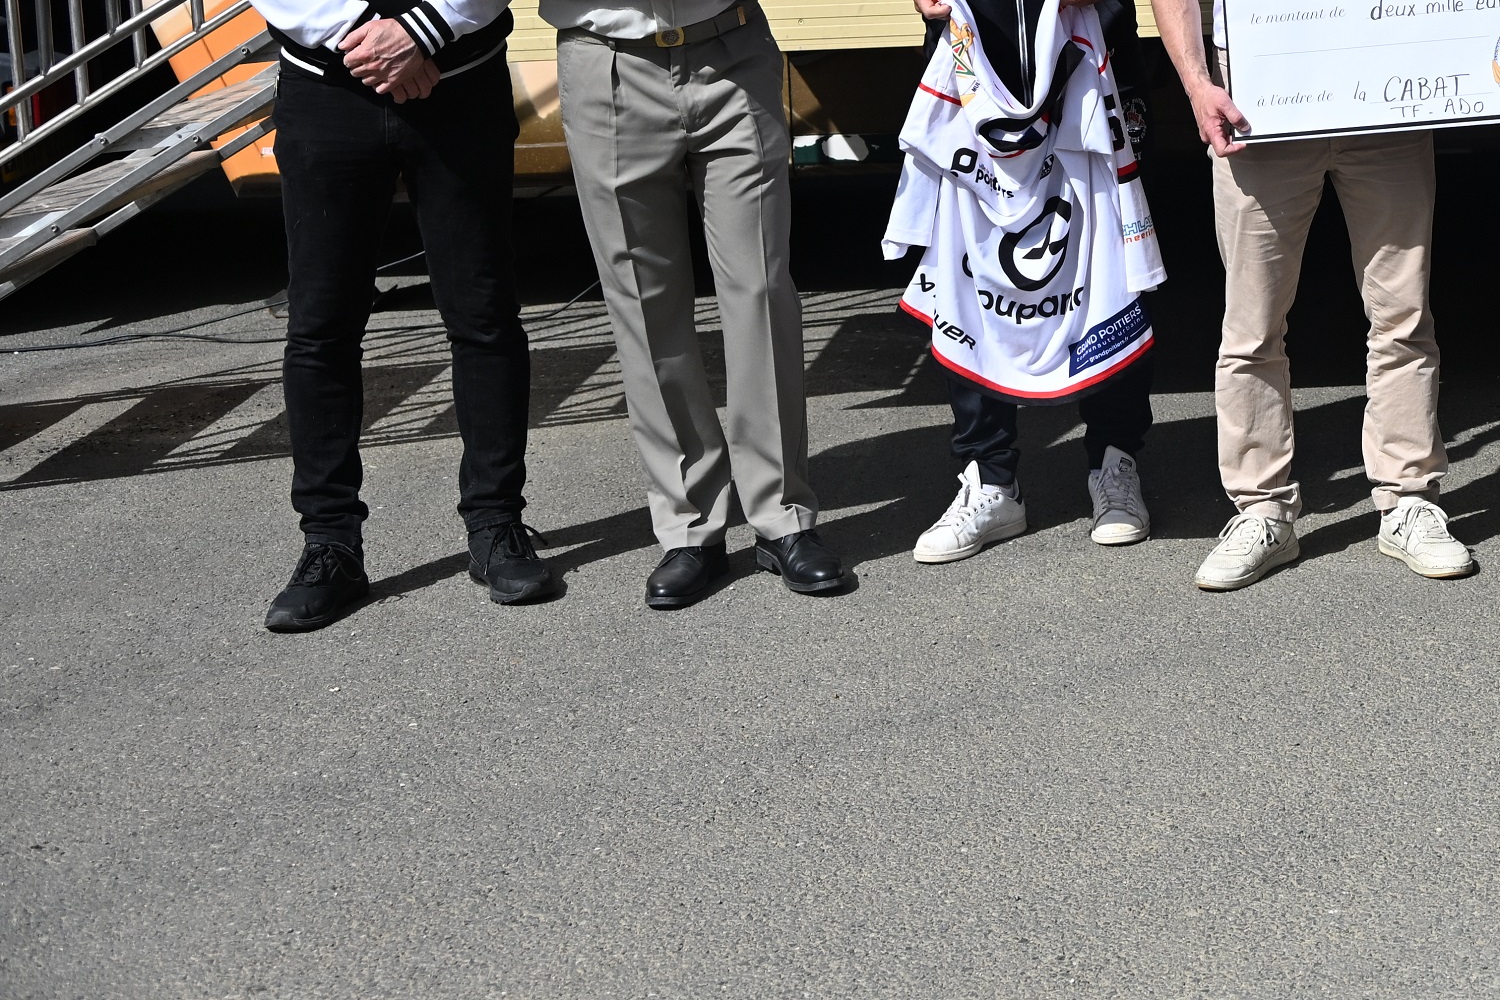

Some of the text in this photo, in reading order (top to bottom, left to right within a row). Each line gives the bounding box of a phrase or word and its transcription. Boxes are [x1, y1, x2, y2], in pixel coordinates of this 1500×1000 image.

[1250, 5, 1347, 25] le montant de
[1270, 91, 1313, 106] l'ordre
[1317, 89, 1335, 102] de
[1353, 80, 1367, 103] la
[1383, 73, 1470, 103] CABAT
[1390, 103, 1424, 118] TF
[1443, 98, 1485, 115] ADO
[975, 168, 1015, 199] poitirs
[1098, 305, 1142, 340] POITIERS
